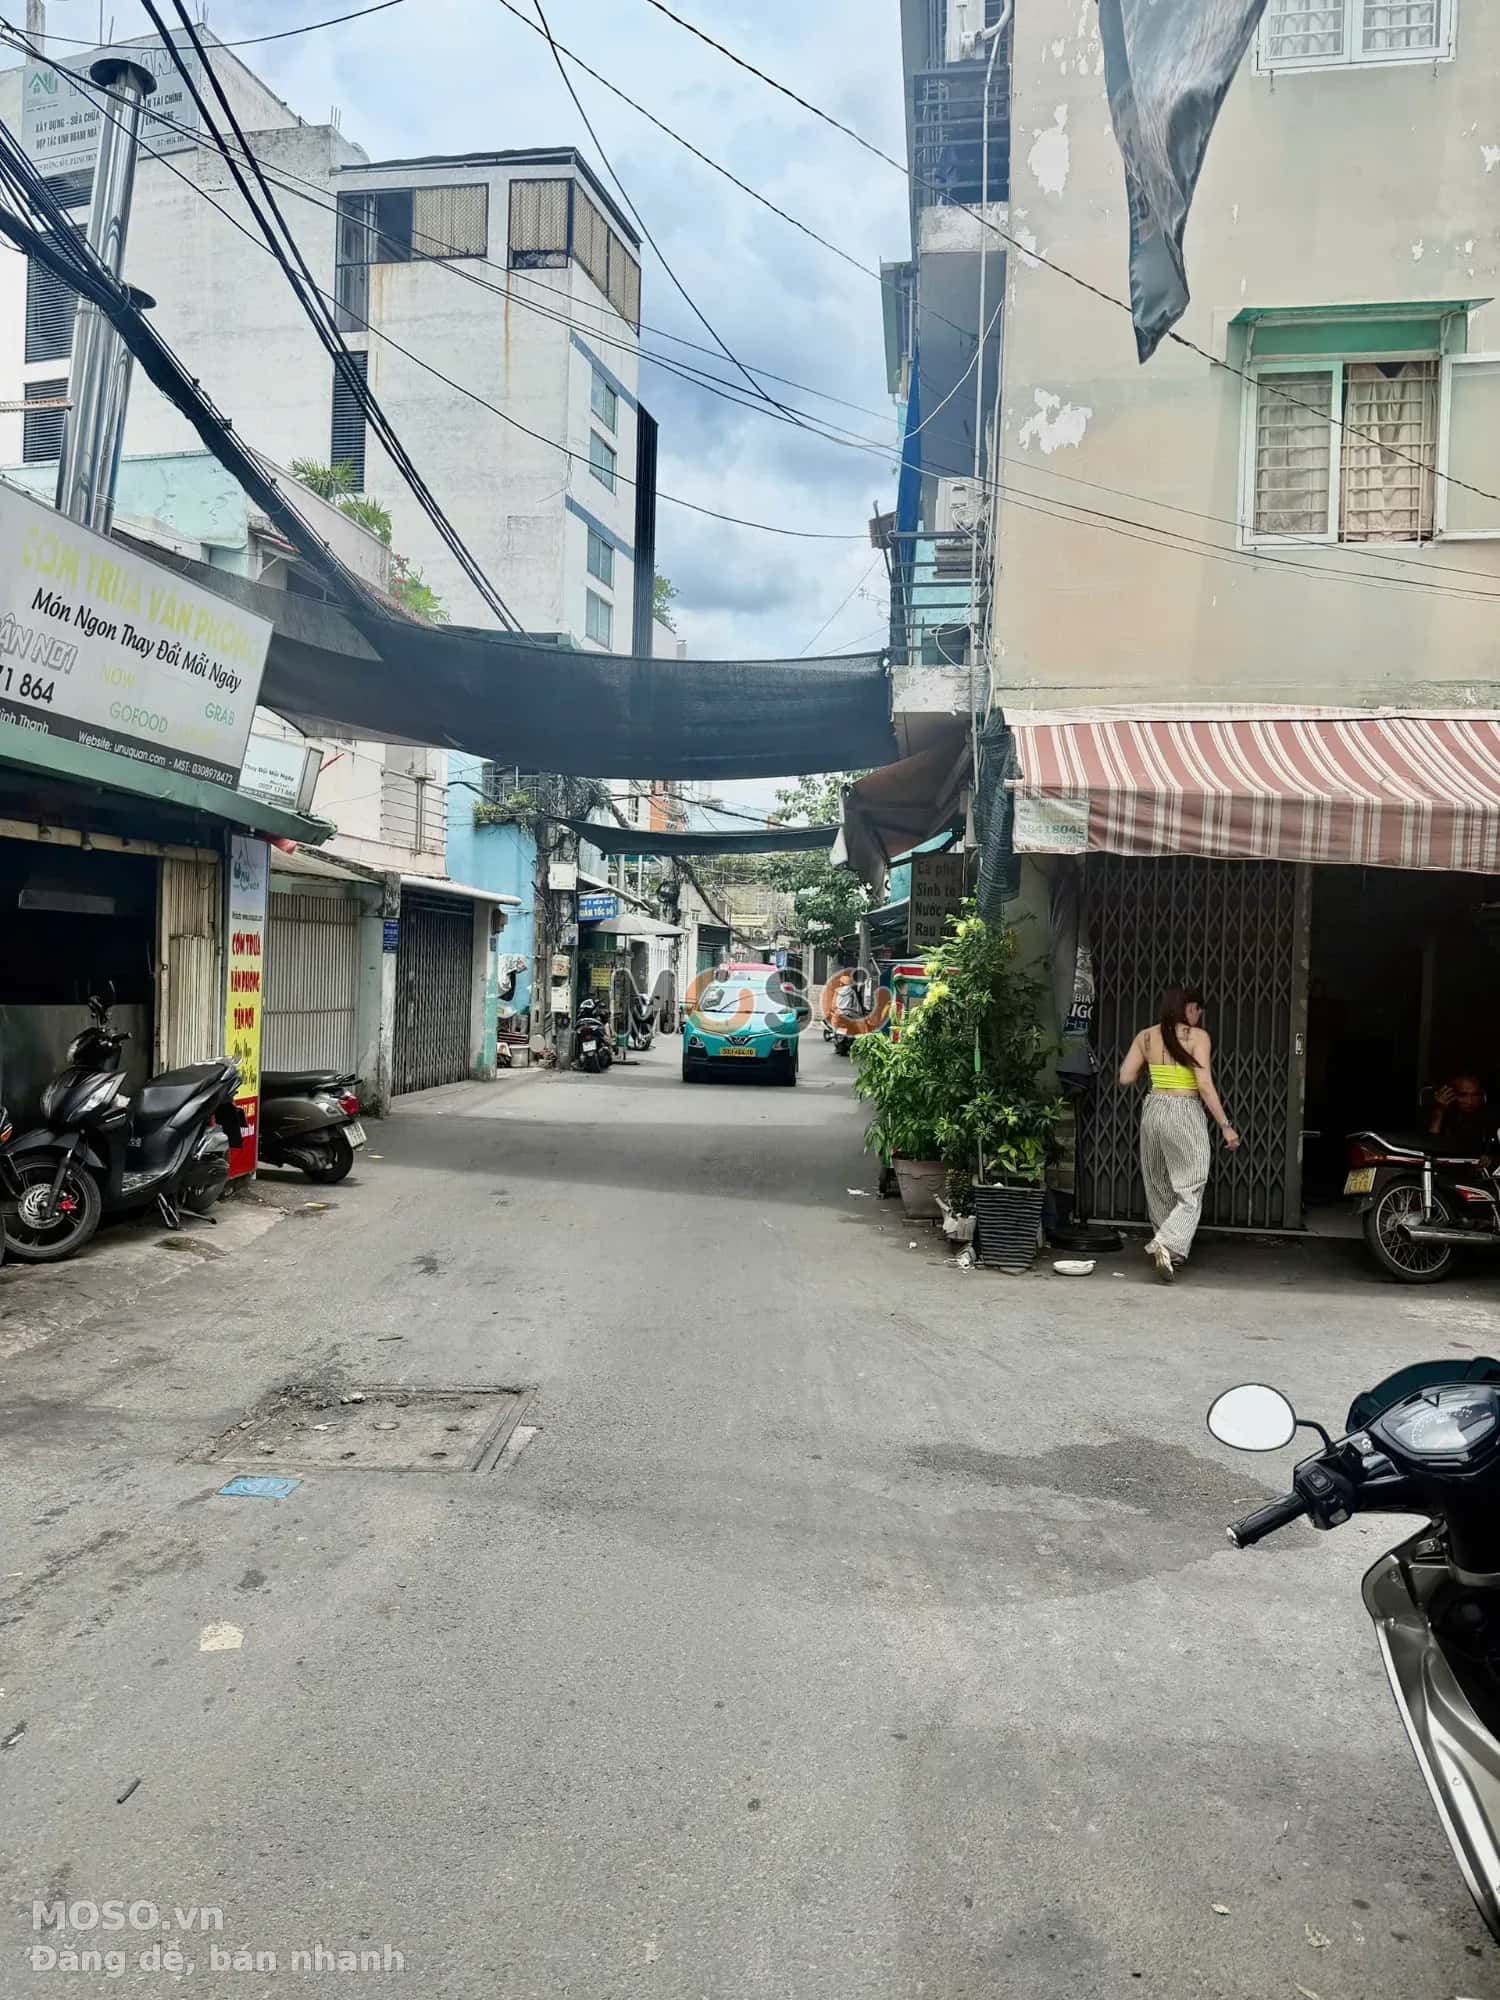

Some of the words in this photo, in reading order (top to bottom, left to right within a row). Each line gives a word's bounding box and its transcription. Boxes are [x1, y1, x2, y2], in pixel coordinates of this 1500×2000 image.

[31, 586, 72, 622] Món
[73, 604, 118, 640] Ngon
[120, 623, 155, 658] Thay
[156, 640, 182, 666] Đổi
[181, 650, 209, 677] Mỗi
[208, 661, 242, 694] Ngày
[20, 673, 55, 704] 864
[110, 701, 168, 733] GOFOOD
[205, 702, 236, 727] GRAB
[78, 731, 113, 751] Website:
[114, 743, 167, 766] unuquan.com
[916, 882, 941, 896] Sinh
[915, 901, 941, 917] Nước
[915, 922, 936, 937] Rau
